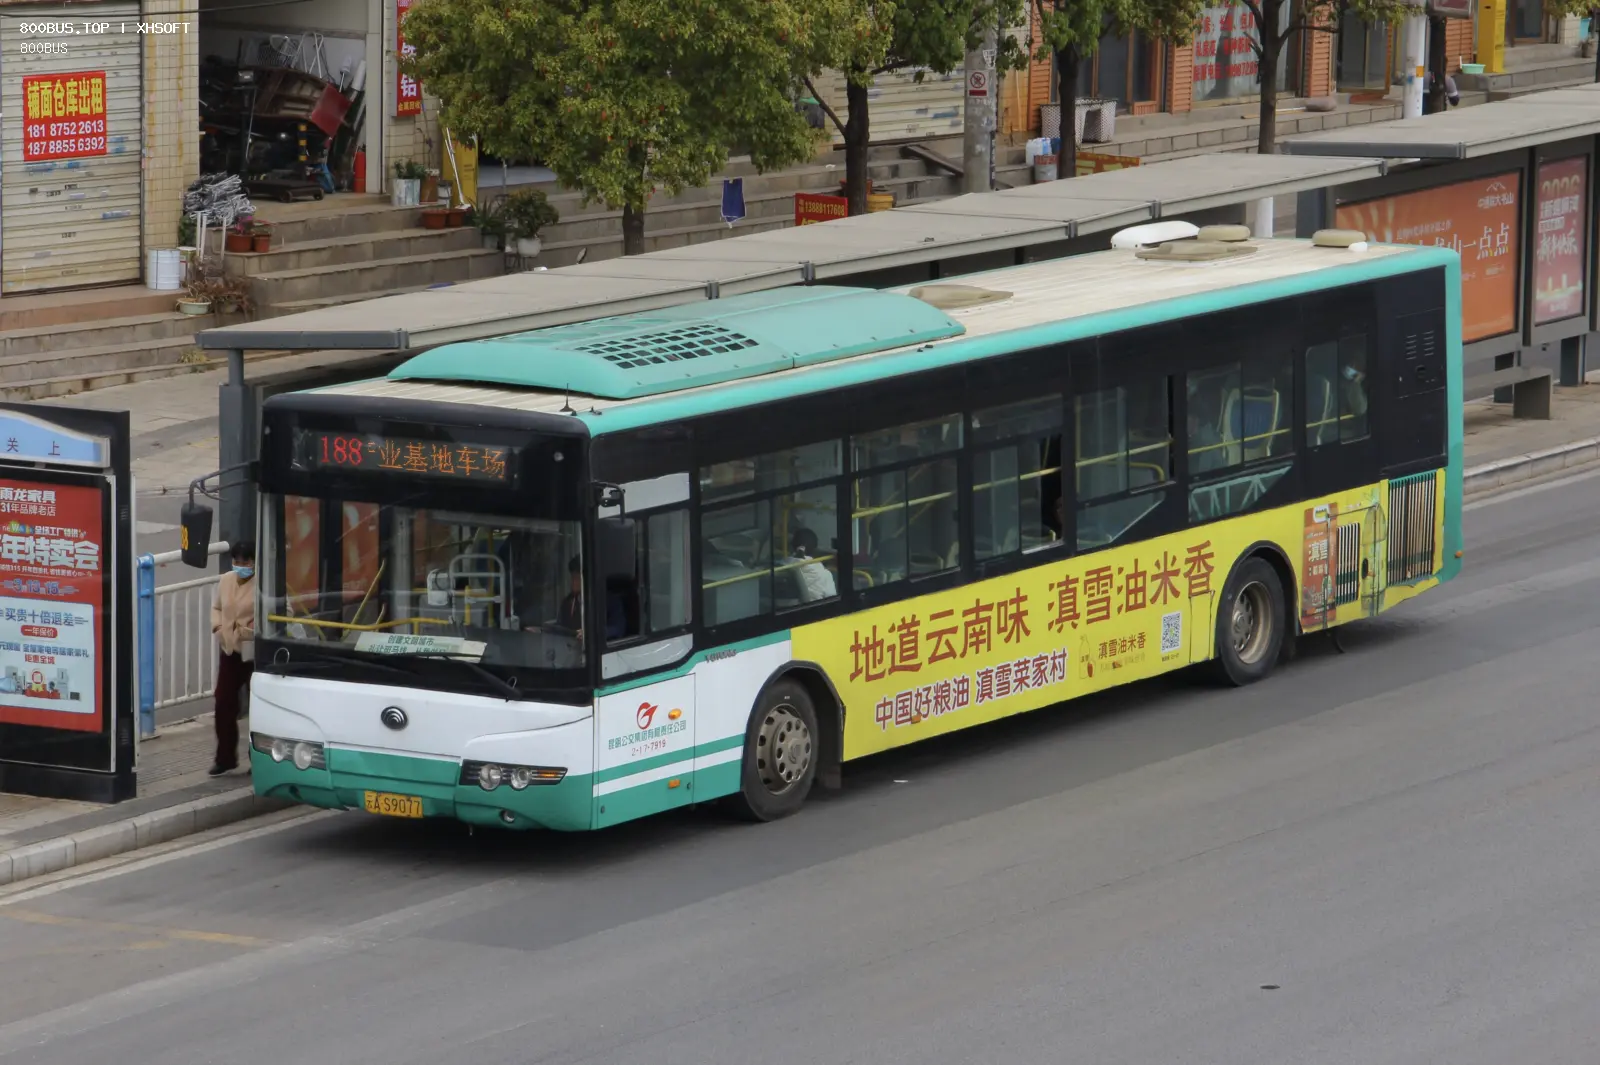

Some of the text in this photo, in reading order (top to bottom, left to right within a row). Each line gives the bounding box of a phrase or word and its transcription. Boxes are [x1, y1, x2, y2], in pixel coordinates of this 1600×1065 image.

[27, 120, 104, 138] 181 8752 2613
[27, 137, 105, 156] 187 8855 6392
[320, 436, 363, 465] 188
[0, 533, 99, 571] 年特卖会
[1048, 540, 1215, 633] 滇雪油米香
[849, 587, 1031, 683] 地道云南味
[1098, 631, 1147, 660] 滇雪油米香
[875, 648, 1068, 731] 中国好粮油 滇雪菜家村
